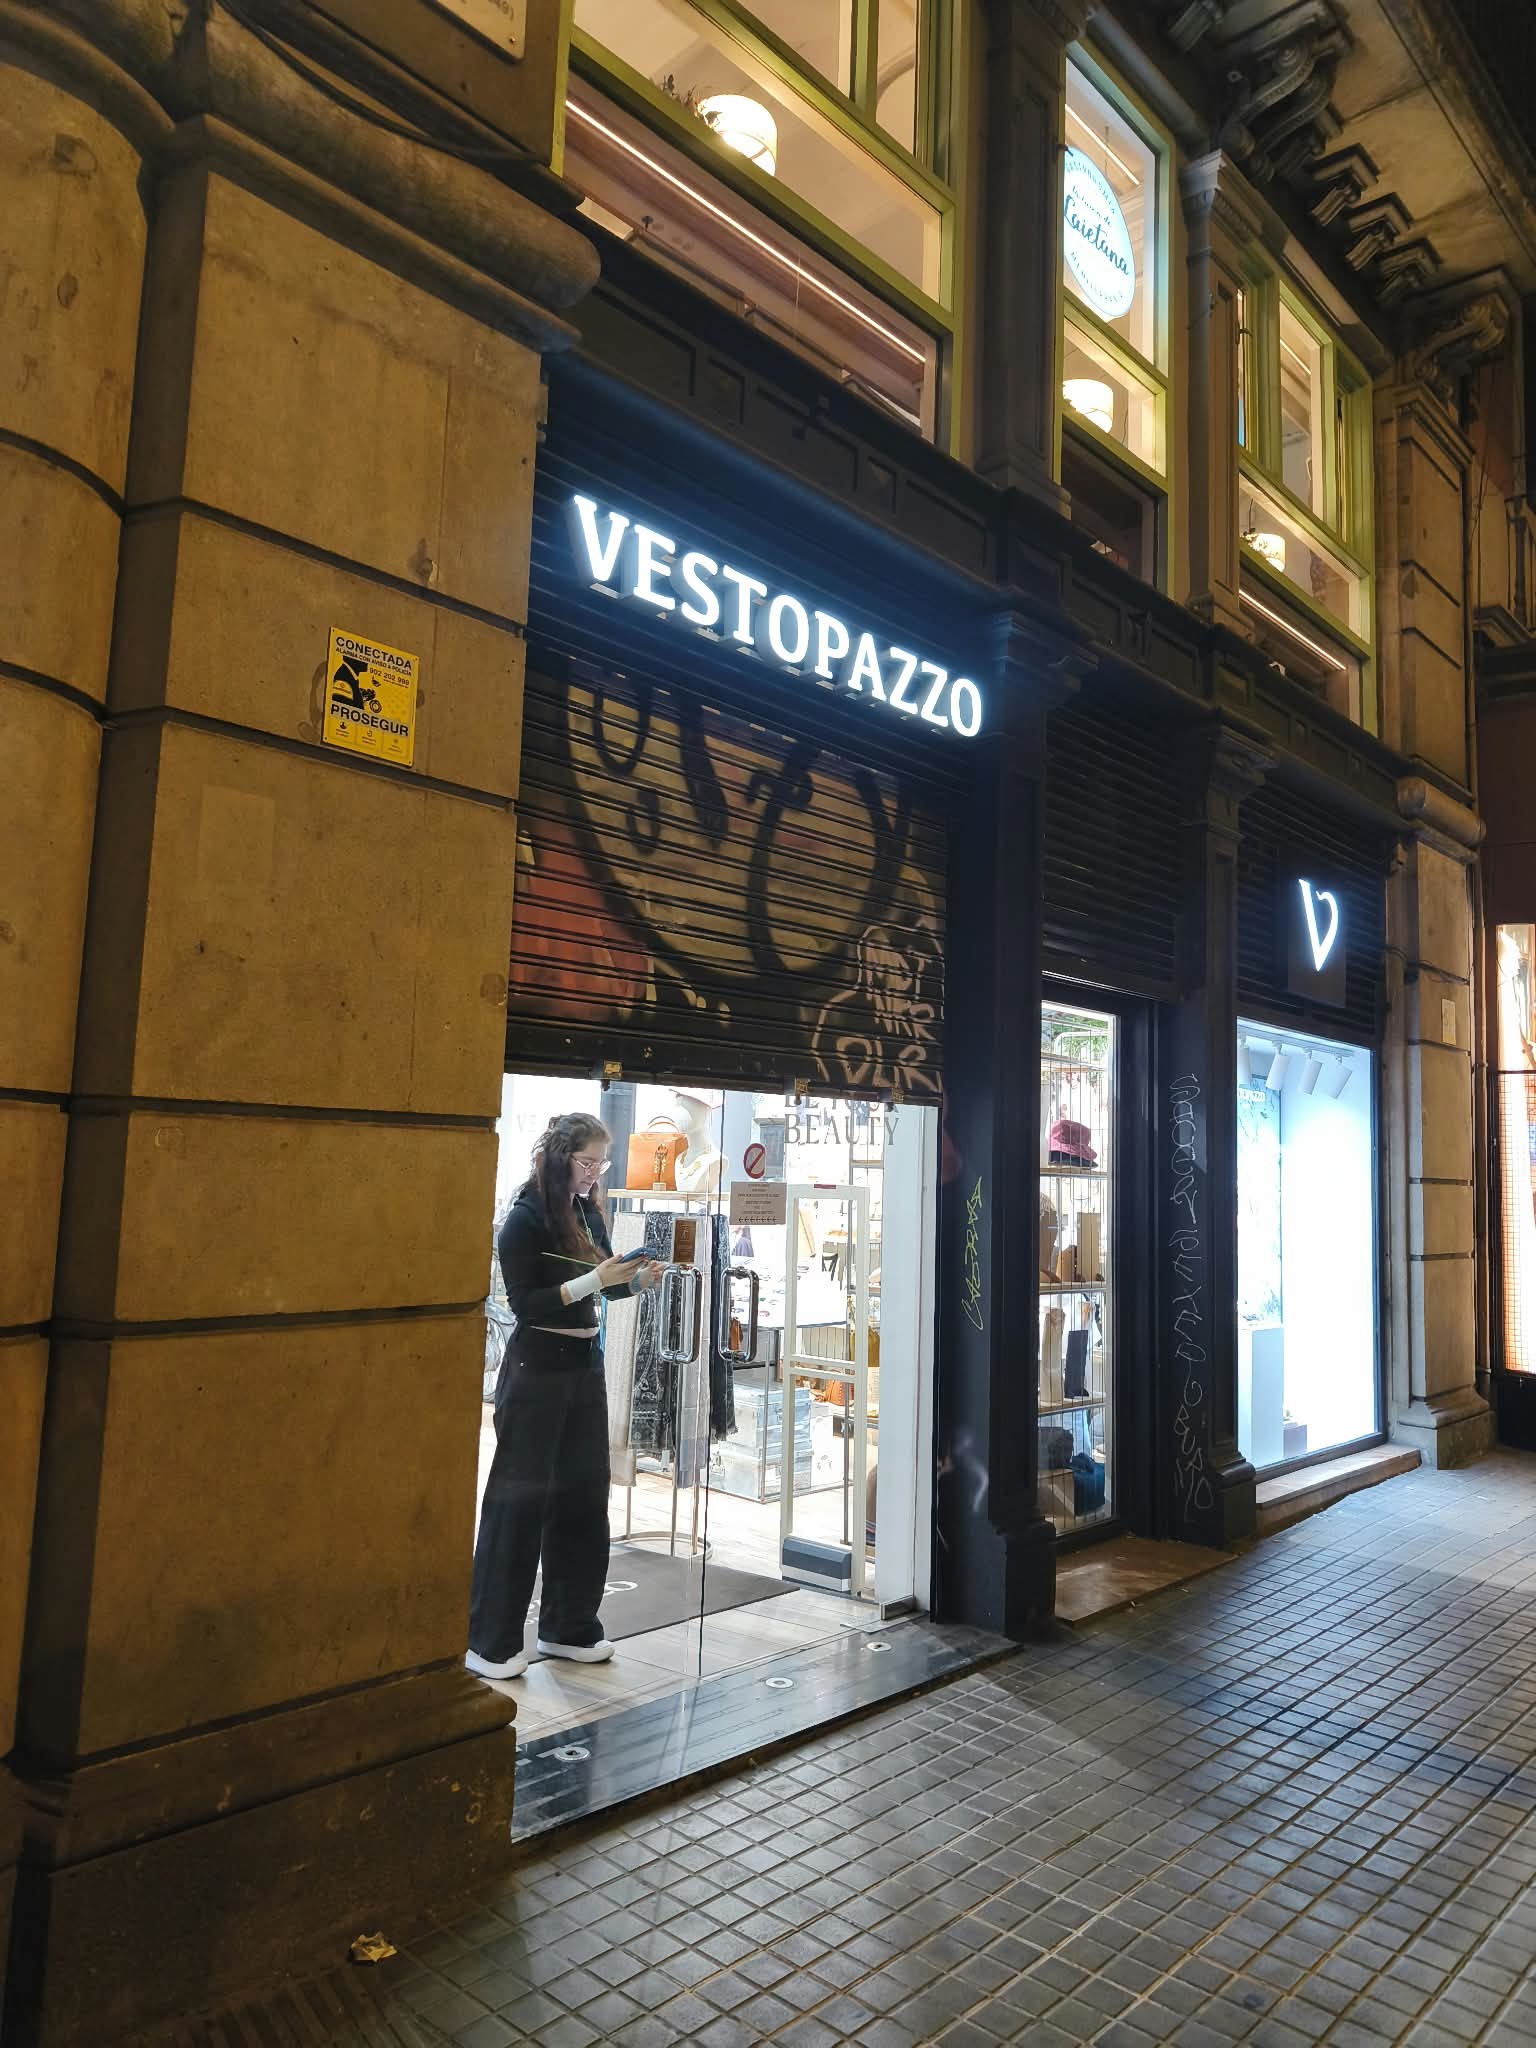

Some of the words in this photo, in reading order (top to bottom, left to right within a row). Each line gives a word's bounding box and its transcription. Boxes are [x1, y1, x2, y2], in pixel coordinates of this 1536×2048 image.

[573, 494, 983, 738] VESTOPAZZO
[336, 636, 412, 670] CONECTADA
[383, 672, 396, 682] 202
[330, 703, 409, 737] PROSEGUR
[783, 1113, 901, 1146] BEAUTY
